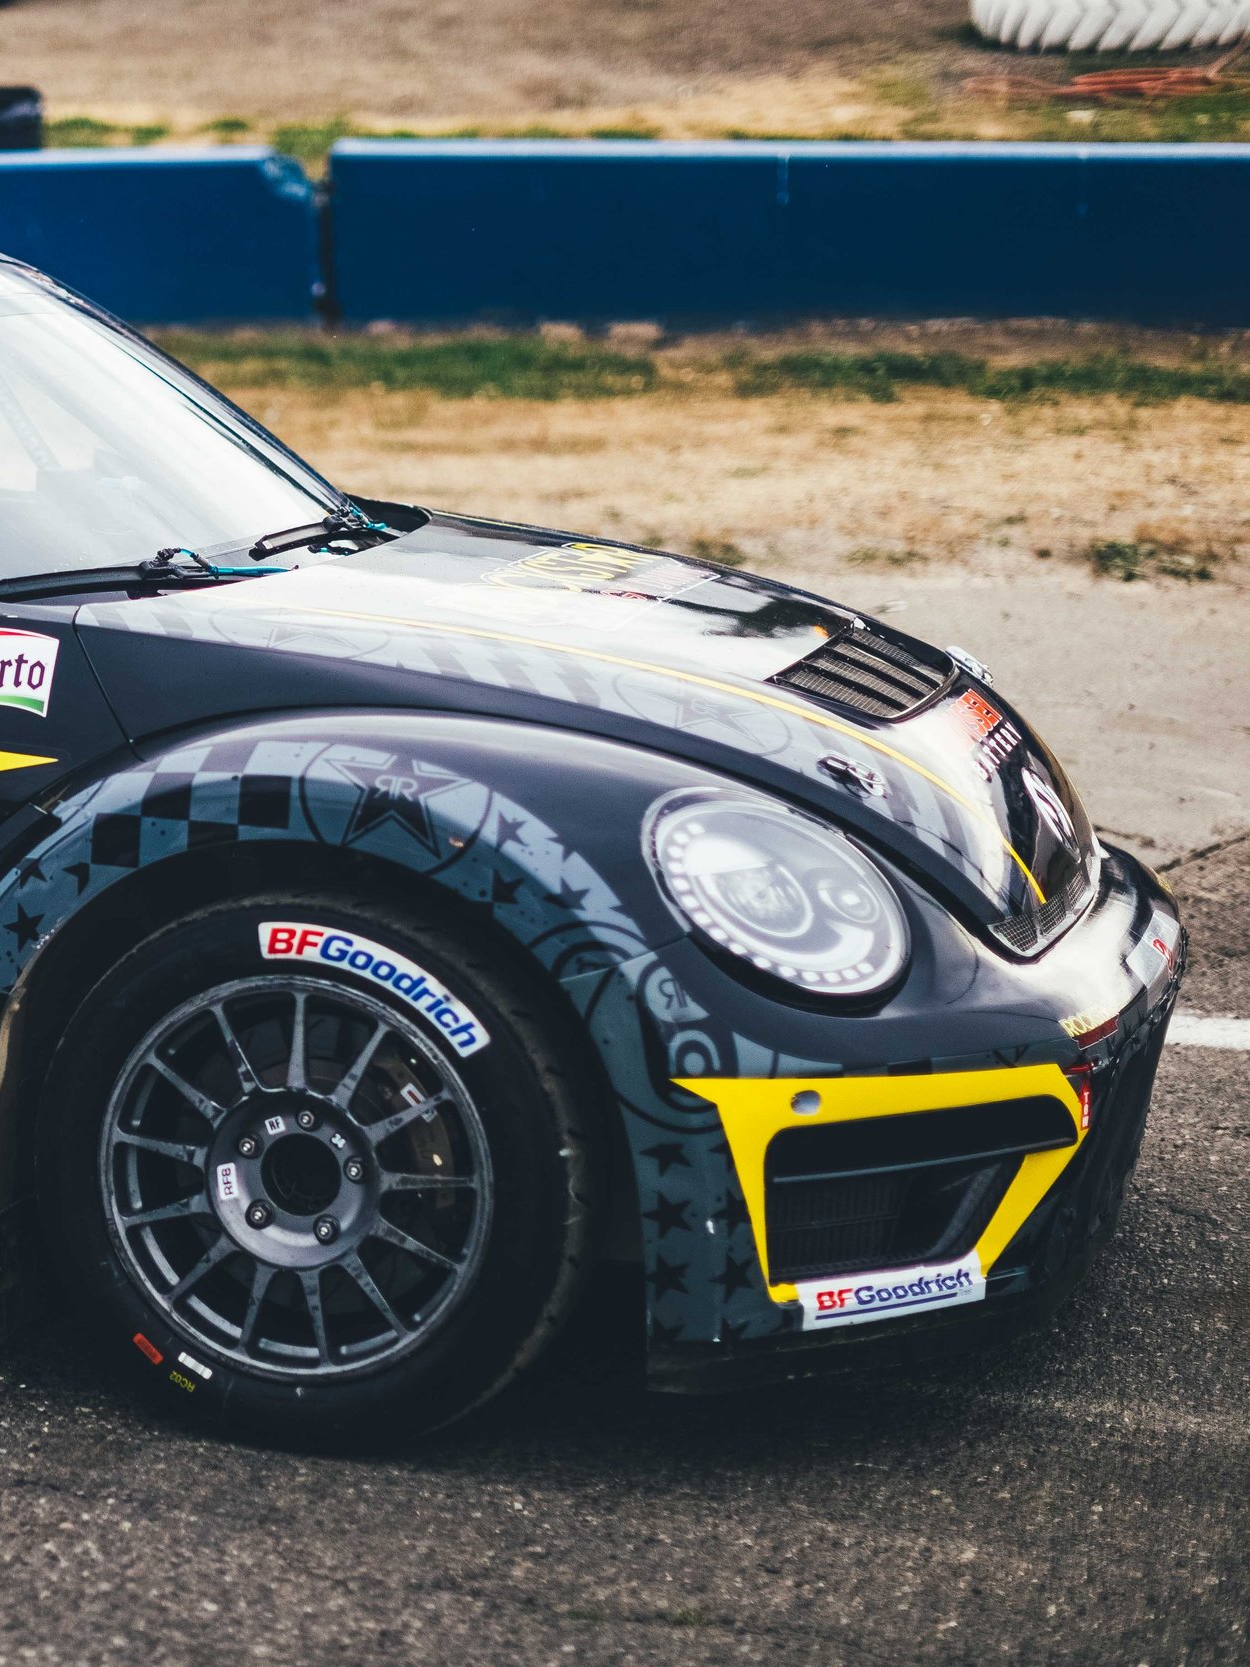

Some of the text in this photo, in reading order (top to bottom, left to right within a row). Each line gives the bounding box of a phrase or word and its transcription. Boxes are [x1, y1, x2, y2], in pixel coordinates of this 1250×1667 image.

[974, 720, 1023, 781] BATTERY
[267, 927, 477, 1048] BFGoodrich
[1081, 1091, 1090, 1127] TOW
[815, 1268, 974, 1312] BFGoodrich
